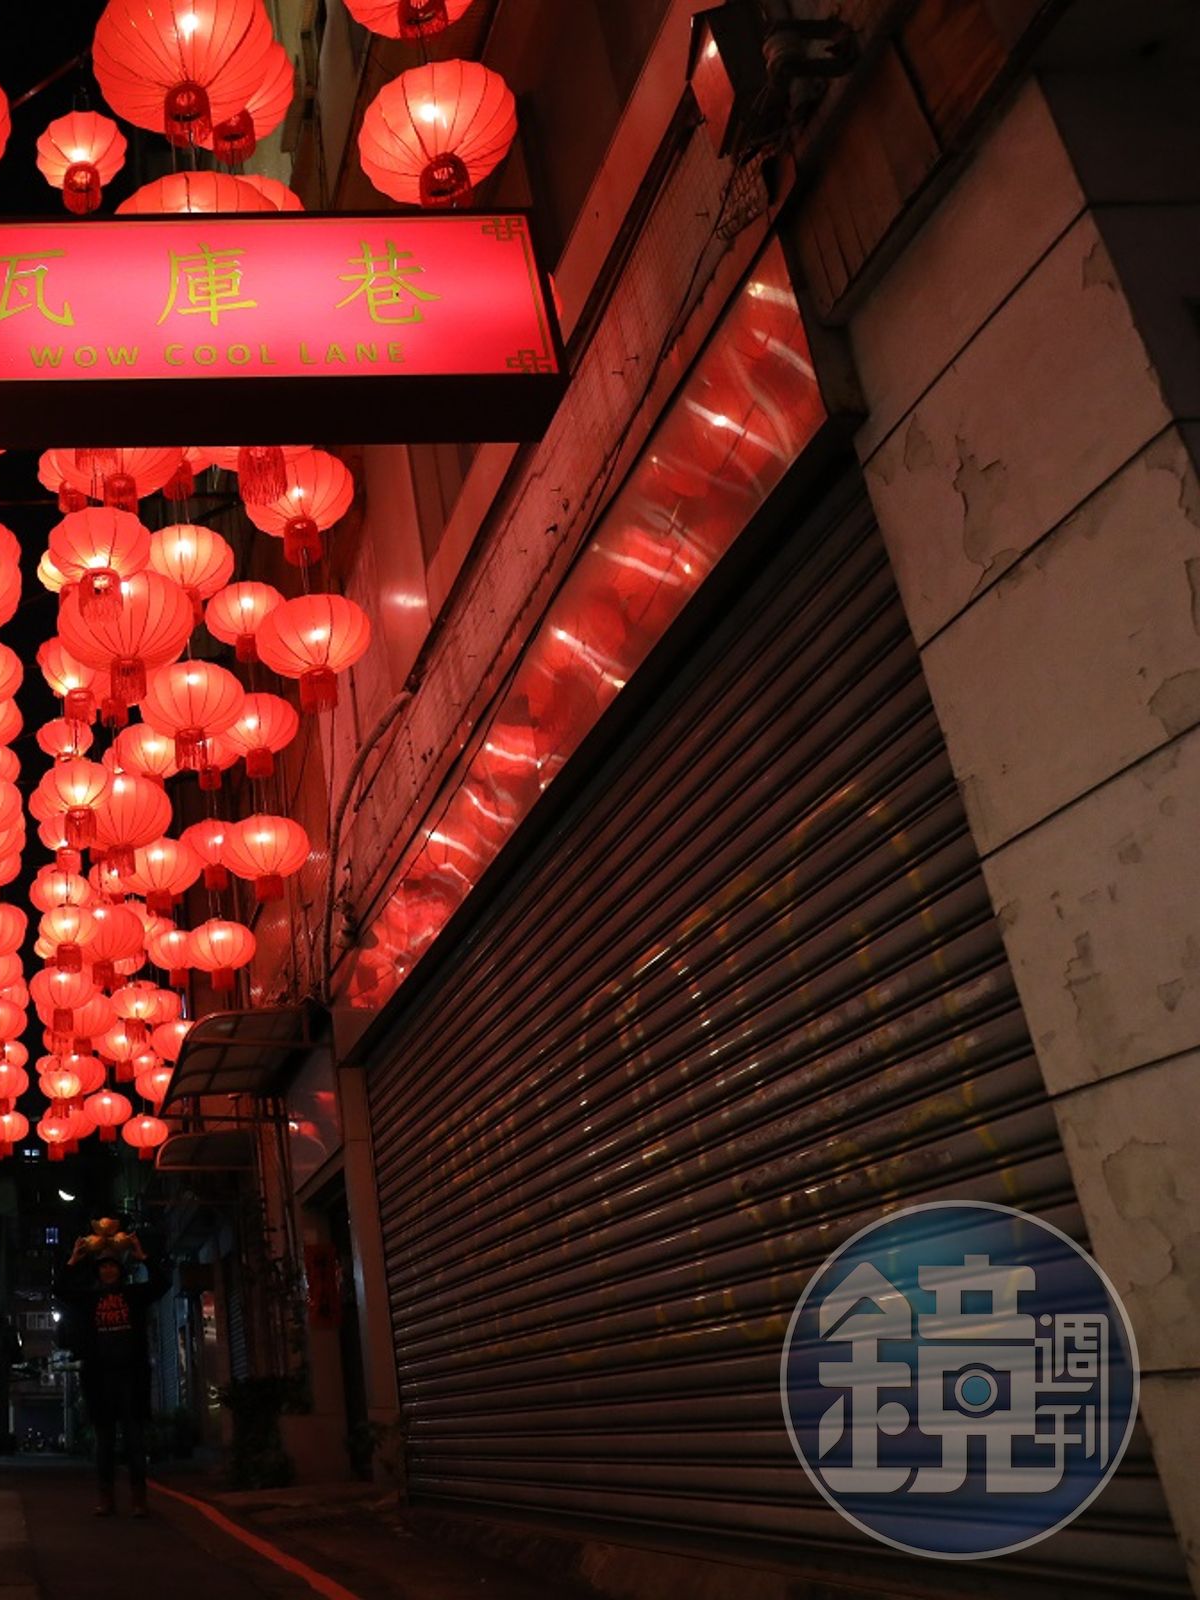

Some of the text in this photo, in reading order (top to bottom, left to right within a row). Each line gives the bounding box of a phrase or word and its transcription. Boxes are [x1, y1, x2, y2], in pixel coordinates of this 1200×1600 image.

[30, 341, 405, 368] WOW COOL LANE
